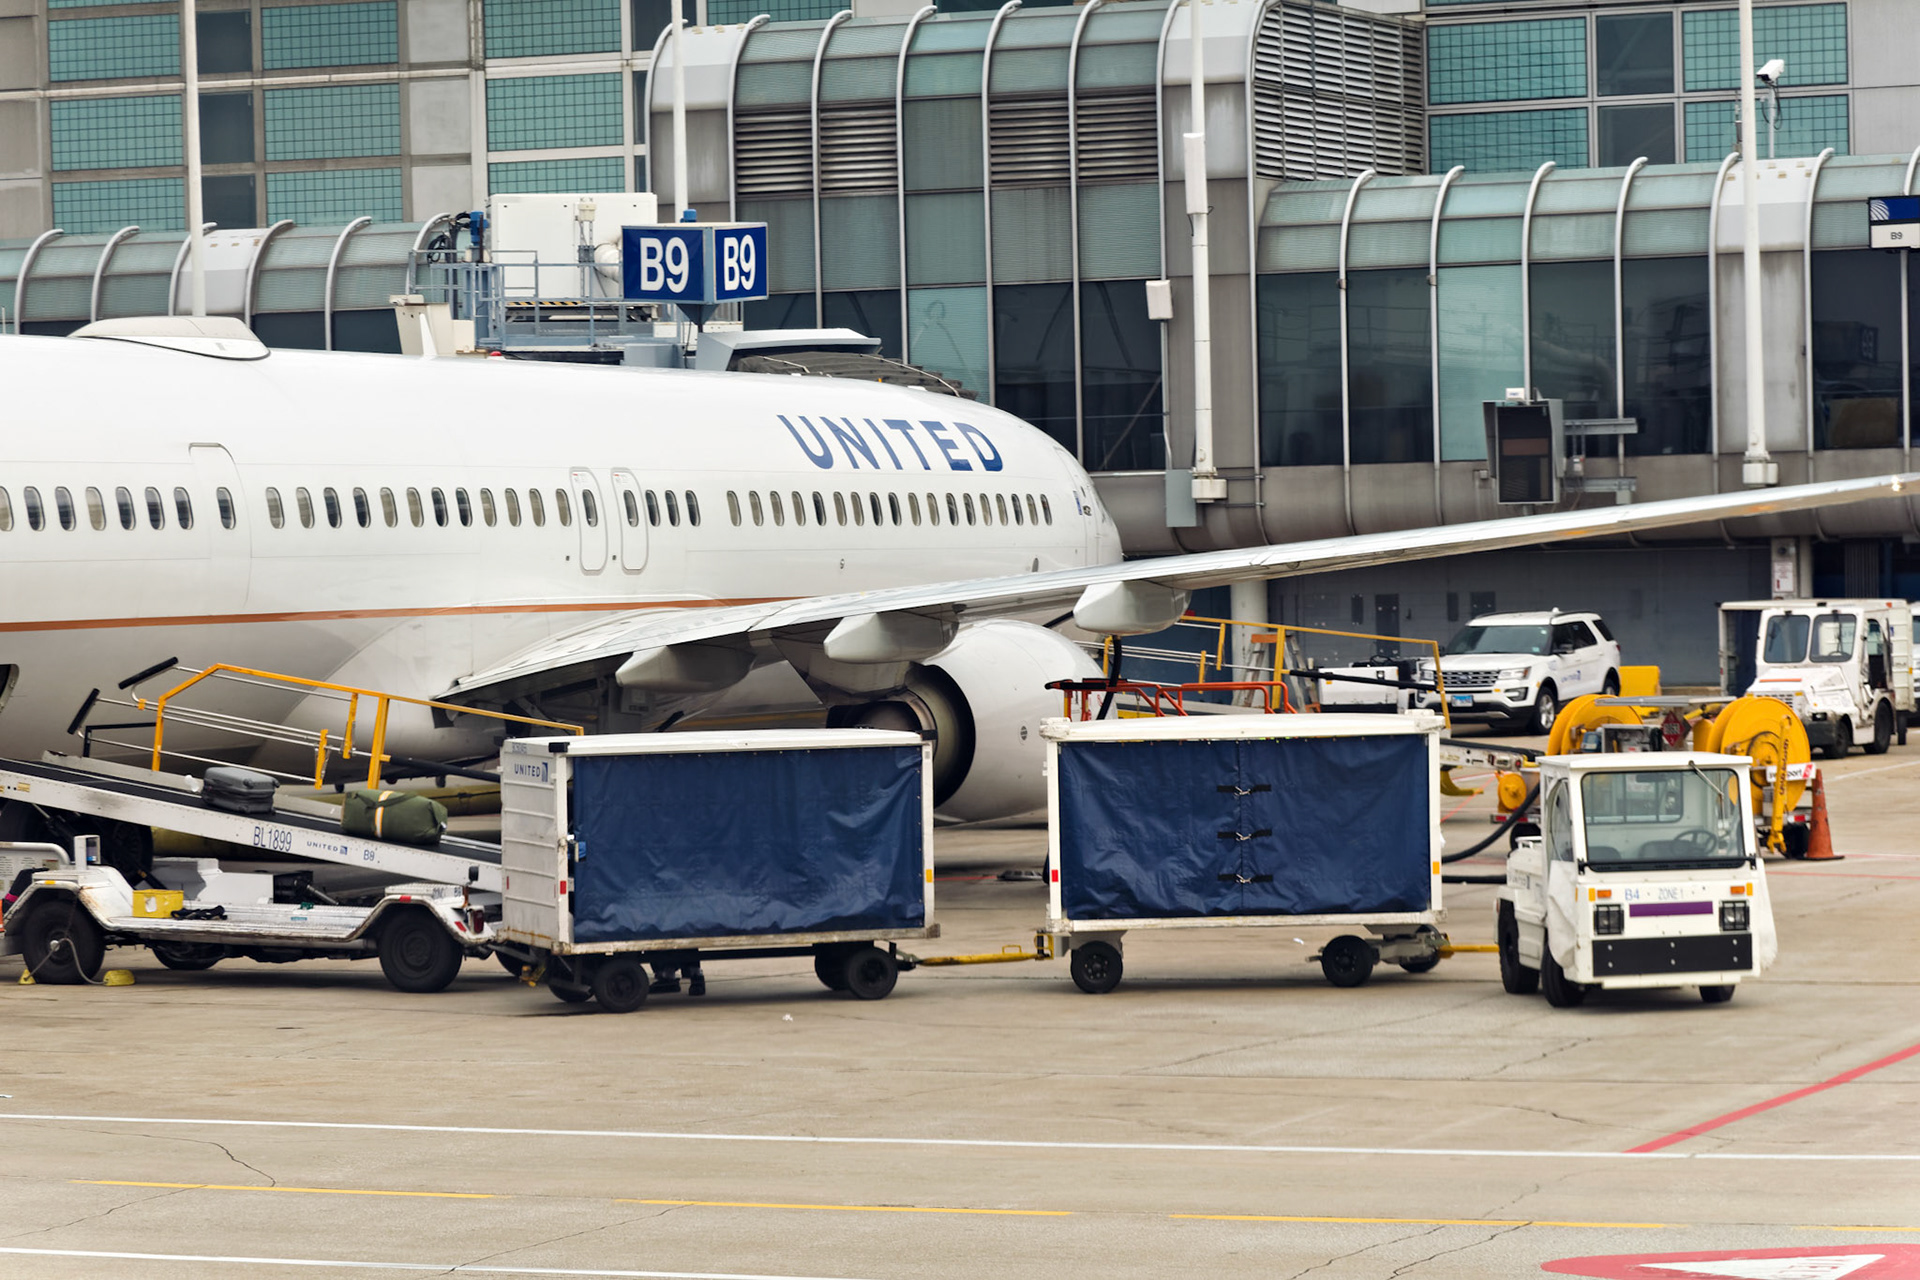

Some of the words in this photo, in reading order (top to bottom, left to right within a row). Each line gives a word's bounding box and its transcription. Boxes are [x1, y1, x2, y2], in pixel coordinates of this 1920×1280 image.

[640, 236, 690, 294] B9
[724, 234, 756, 291] B9
[777, 414, 1004, 472] UNITED
[514, 763, 541, 778] UNITED
[253, 826, 292, 852] BL1899
[306, 841, 339, 852] UNITED
[1624, 887, 1640, 901] B4
[1658, 886, 1678, 901] ZONE
